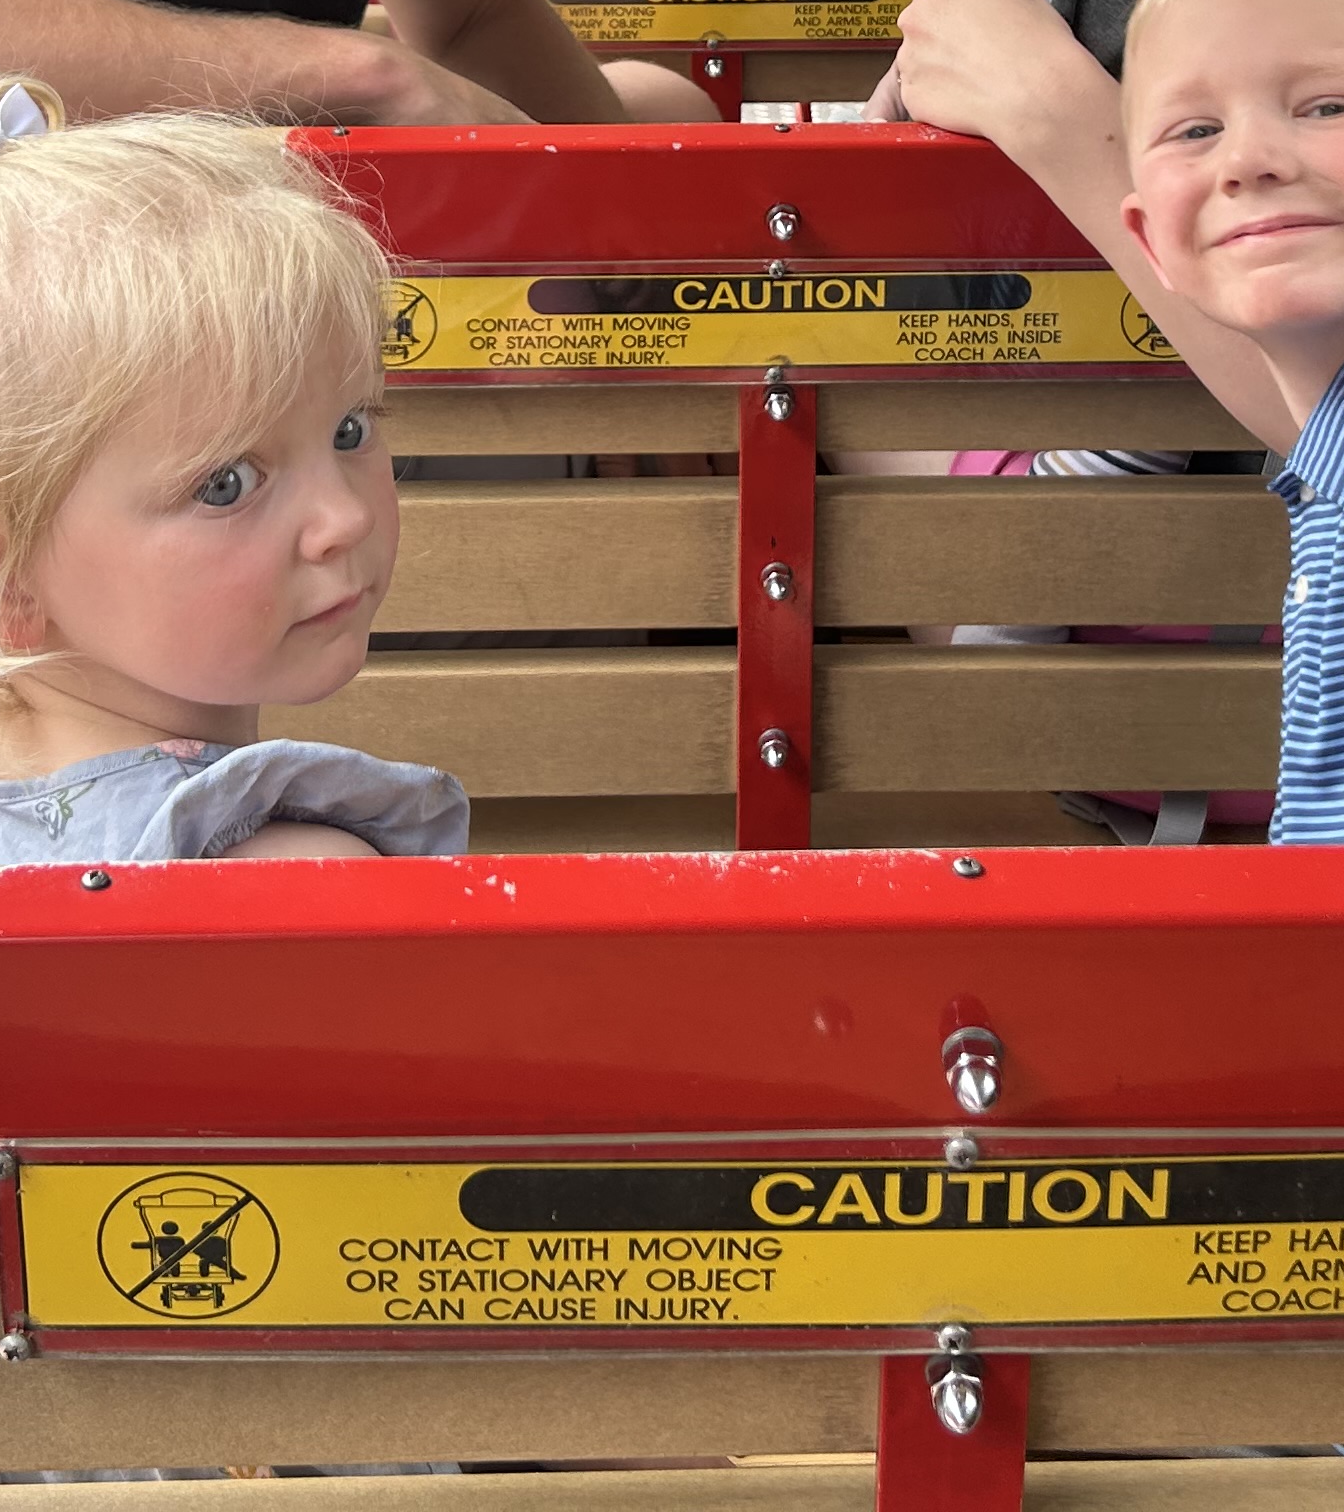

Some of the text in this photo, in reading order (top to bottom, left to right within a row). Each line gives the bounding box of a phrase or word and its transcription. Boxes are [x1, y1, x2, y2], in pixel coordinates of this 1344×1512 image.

[569, 7, 596, 17] WITH
[602, 6, 656, 17] MOVING
[794, 4, 822, 15] KEEP
[877, 3, 901, 14] FEET
[608, 18, 654, 29] OBJECT
[793, 15, 898, 27] AND ARMS INSID
[805, 27, 890, 38] COACH AREA
[673, 279, 886, 310] CAUTION
[467, 317, 691, 333] CONTACT WITH MOVING
[899, 312, 1059, 329] KEEP HANDS, FEET
[470, 334, 688, 350] OR STATIONARY OBJECT
[896, 329, 1062, 345] AND ARMS INSIDE
[489, 350, 670, 366] CAN CAUSE INJURY.
[914, 346, 1041, 361] COACH AREA
[750, 1168, 1170, 1226] CAUTION
[338, 1237, 784, 1262] CONTACT WITH MOVING
[1193, 1230, 1271, 1254] KEEP
[346, 1267, 777, 1292] OR STATIONARY OBJECT
[1187, 1260, 1267, 1285] AND
[384, 1297, 739, 1321] CAN CAUSE INJURY.
